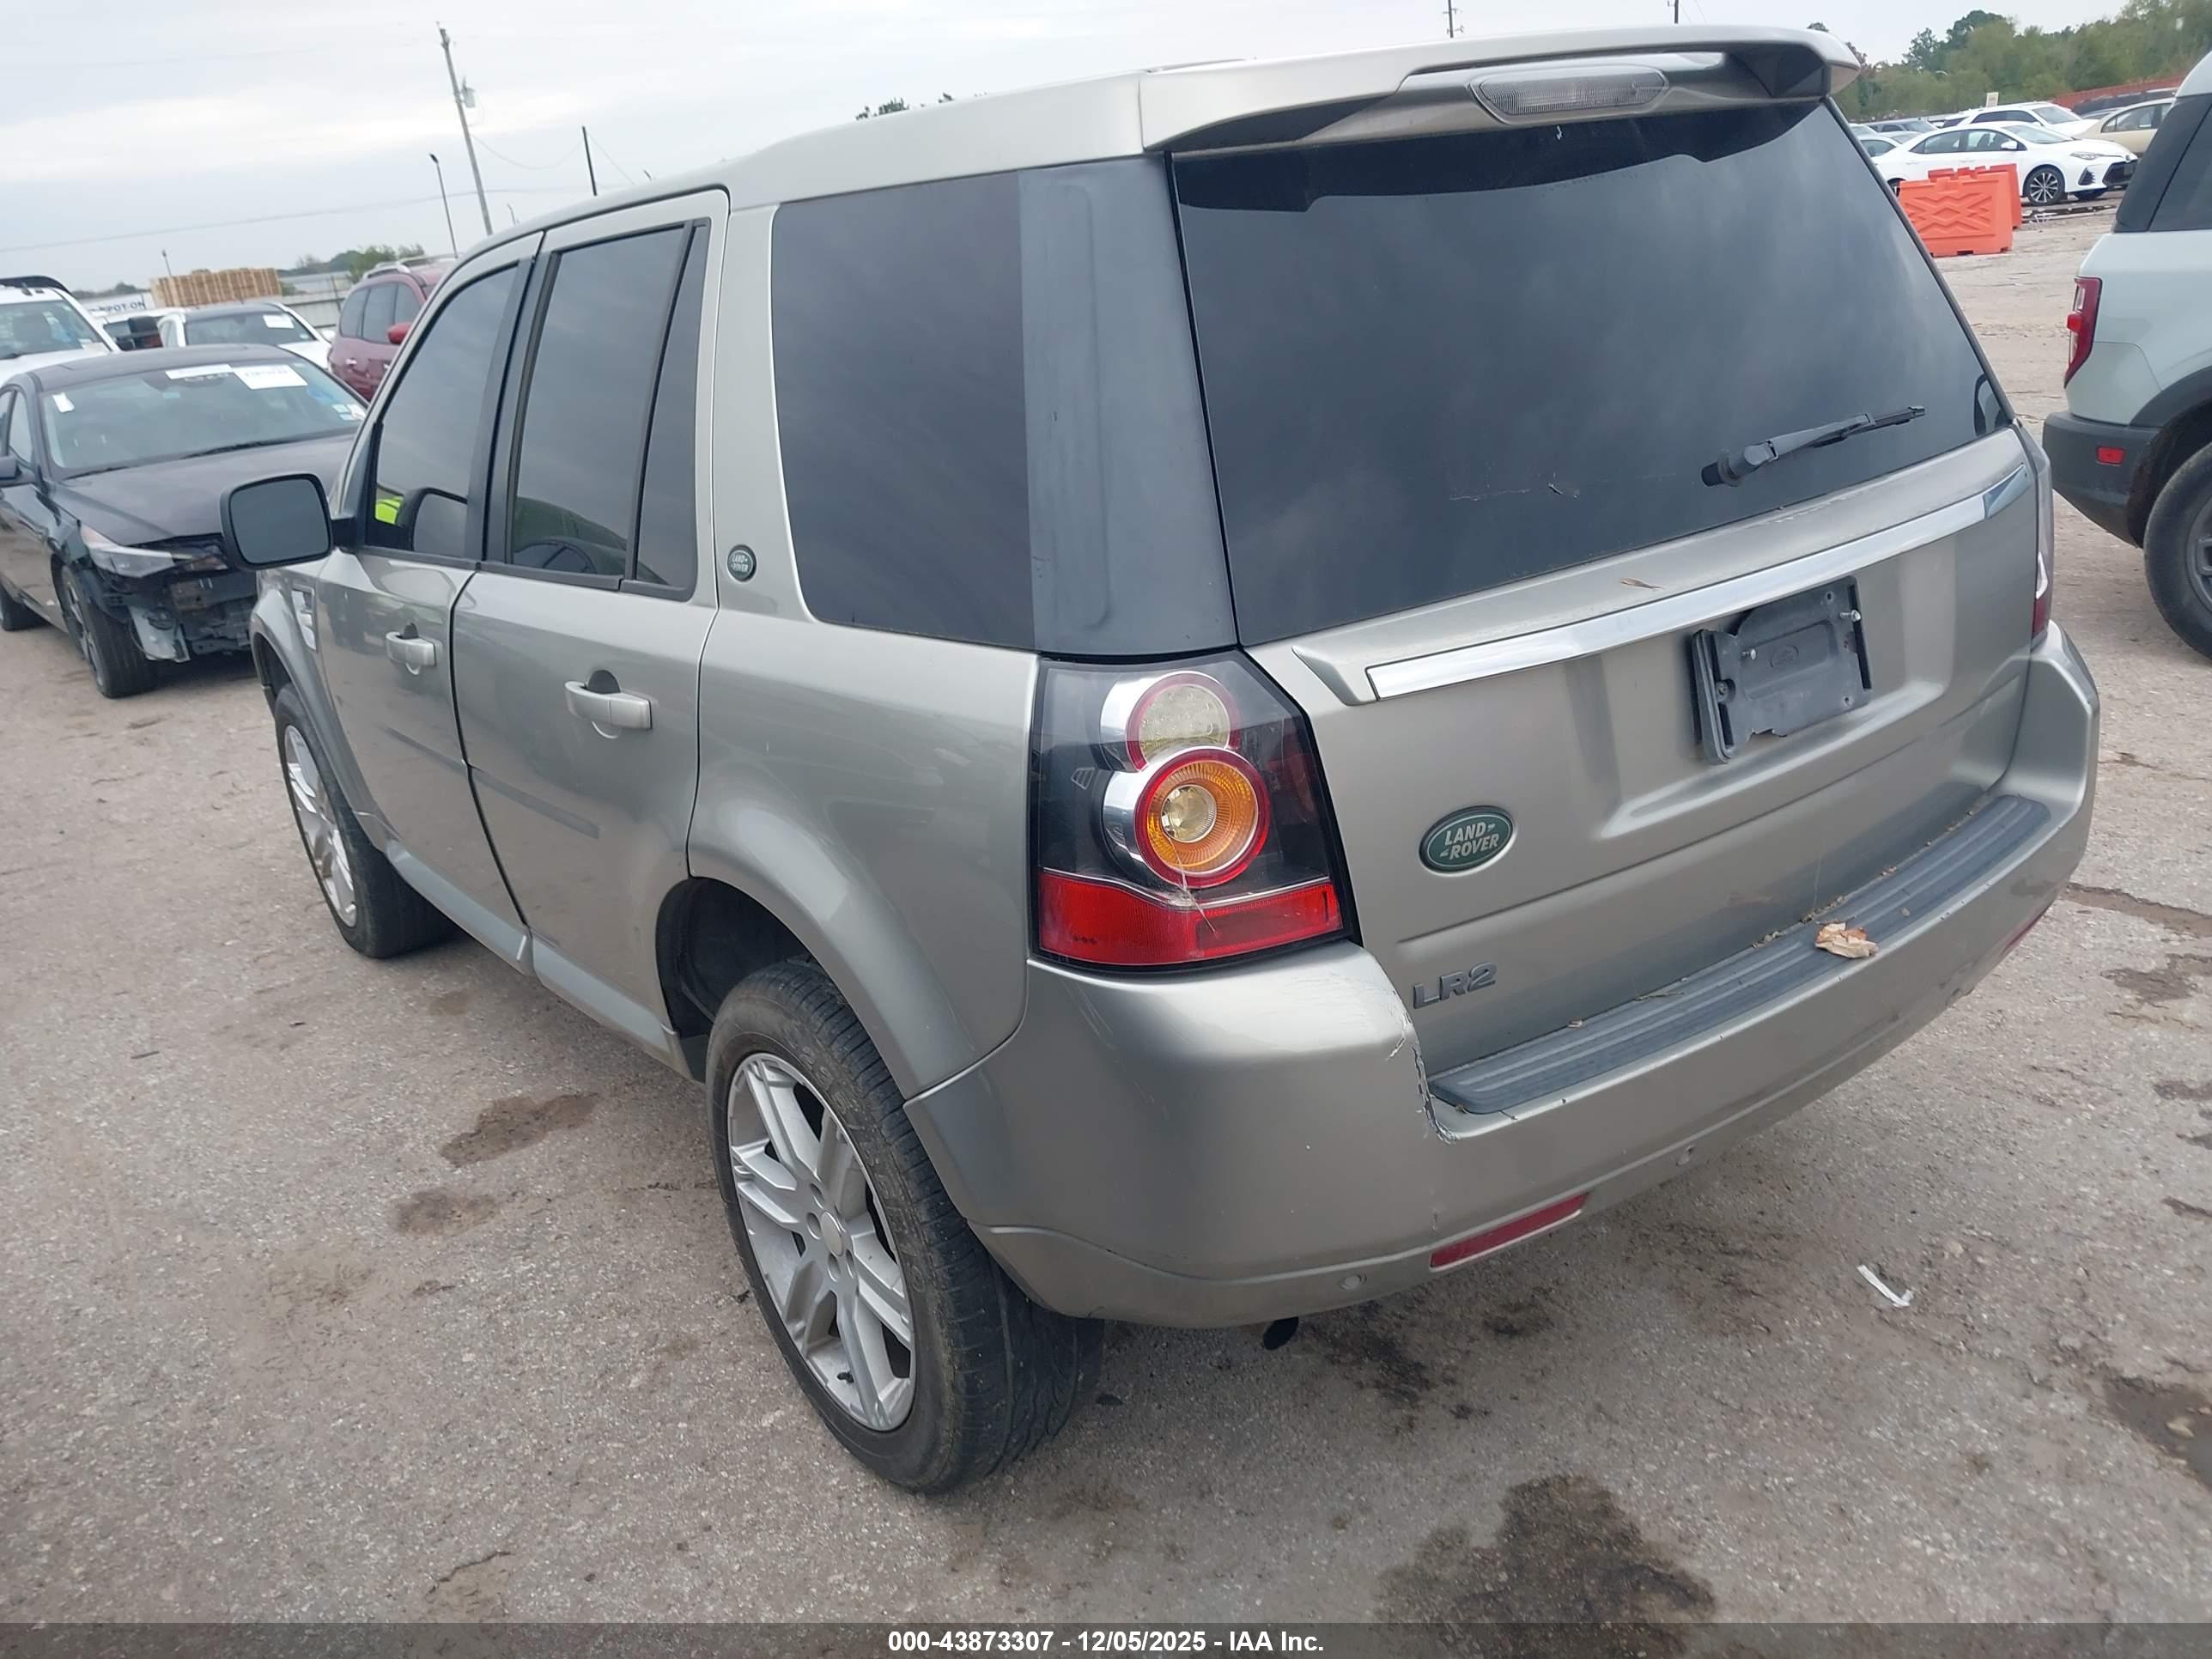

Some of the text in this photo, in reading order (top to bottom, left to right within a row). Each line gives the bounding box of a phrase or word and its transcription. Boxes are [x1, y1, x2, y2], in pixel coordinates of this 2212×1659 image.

[1444, 821, 1486, 846] LAND
[1449, 833, 1500, 860] ROVER
[1413, 962, 1497, 1009] LR2
